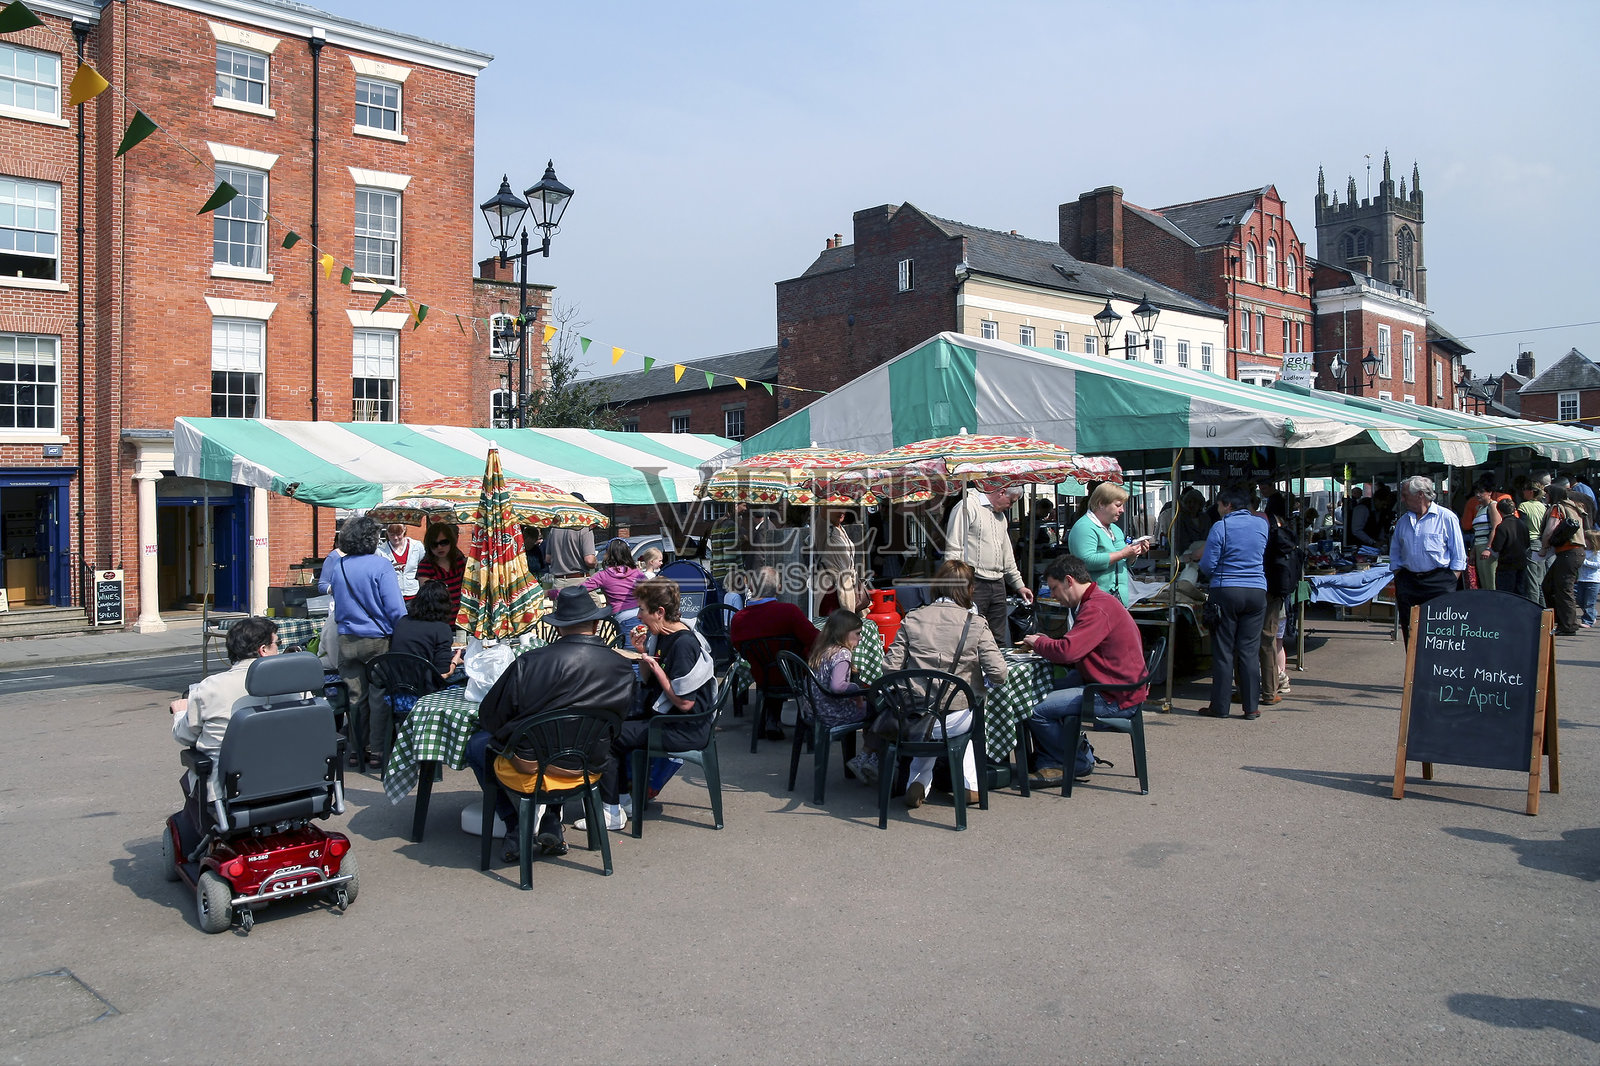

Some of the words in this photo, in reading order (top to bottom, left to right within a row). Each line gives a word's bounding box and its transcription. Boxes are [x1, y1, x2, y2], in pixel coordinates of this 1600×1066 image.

[1287, 356, 1308, 368] get
[1223, 448, 1249, 461] Fairtrade
[97, 592, 120, 601] WINES
[1427, 605, 1469, 621] Ludlow
[1426, 622, 1456, 636] Local
[1460, 623, 1500, 640] Produce
[1425, 635, 1466, 651] Market
[1433, 664, 1466, 679] Next
[1474, 668, 1523, 686] Market
[1467, 686, 1511, 713] April
